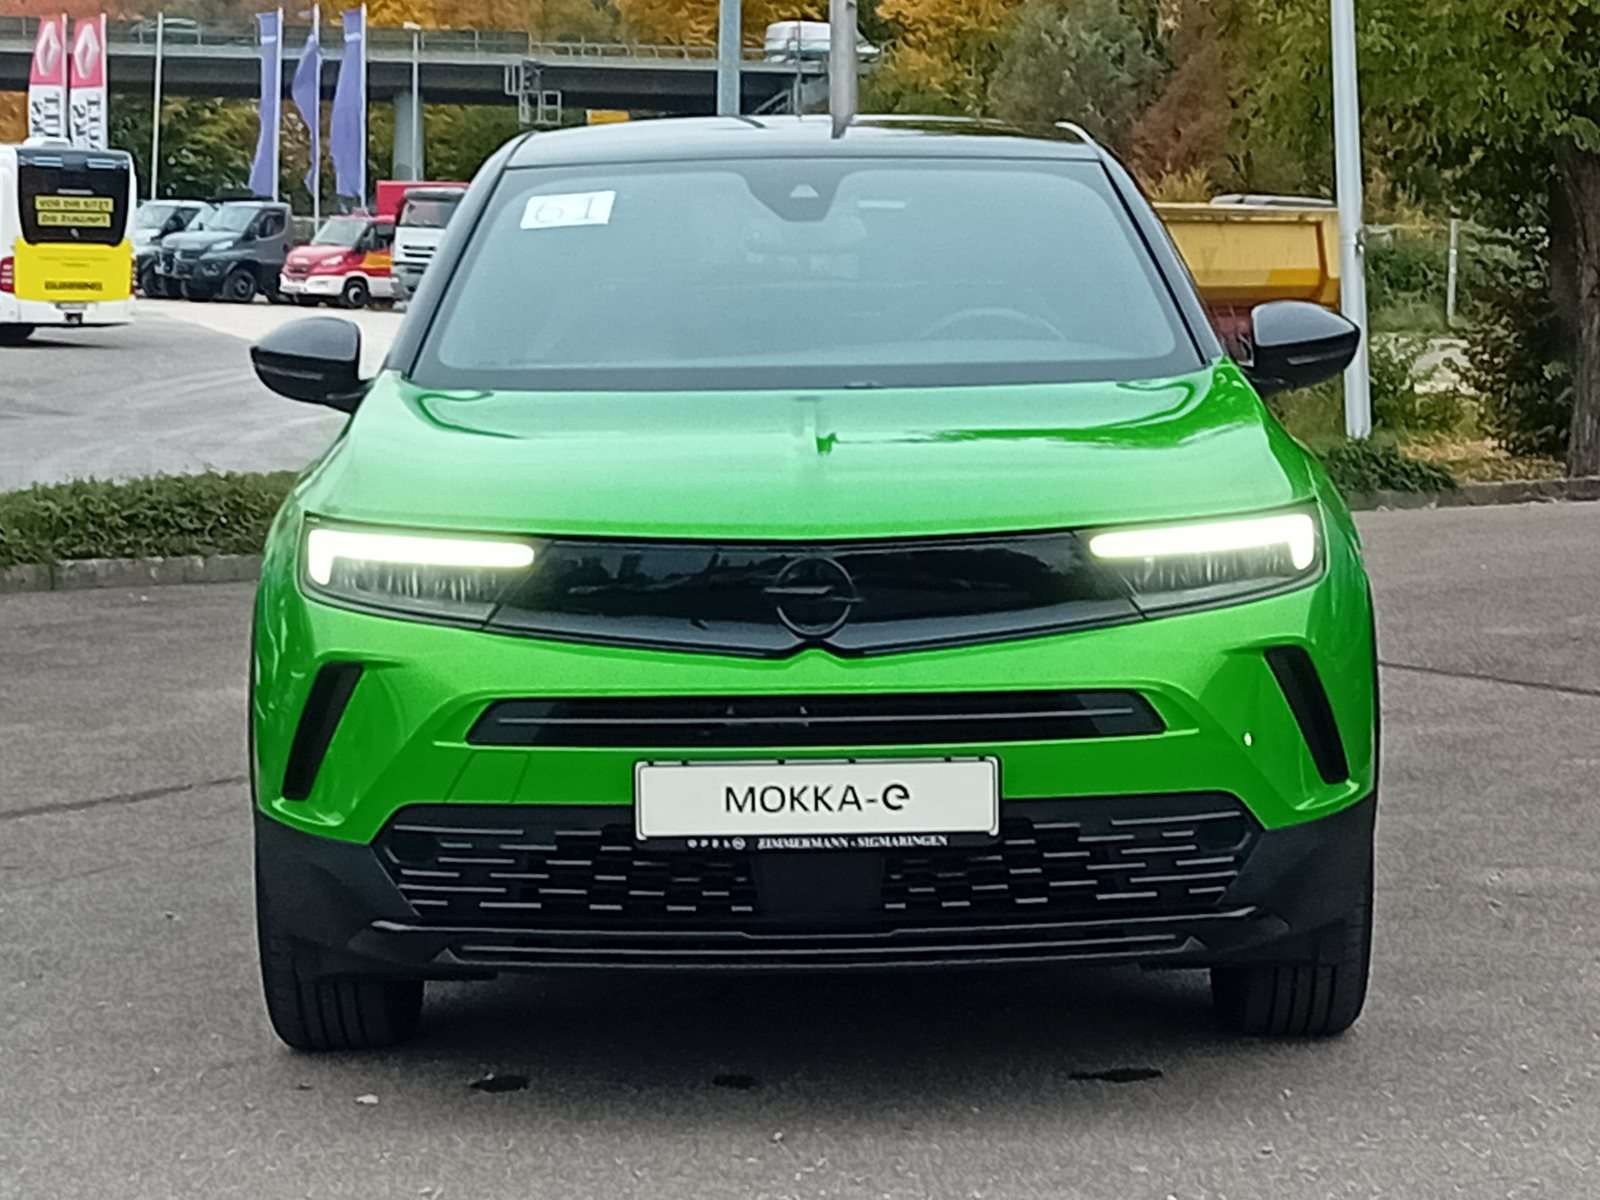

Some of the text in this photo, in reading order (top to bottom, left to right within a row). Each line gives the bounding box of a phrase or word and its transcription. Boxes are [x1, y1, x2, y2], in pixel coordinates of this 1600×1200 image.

[724, 782, 910, 814] MOKKA-e
[757, 836, 849, 851] ZIMMERMANN
[857, 834, 948, 848] SIGMARINGEN
